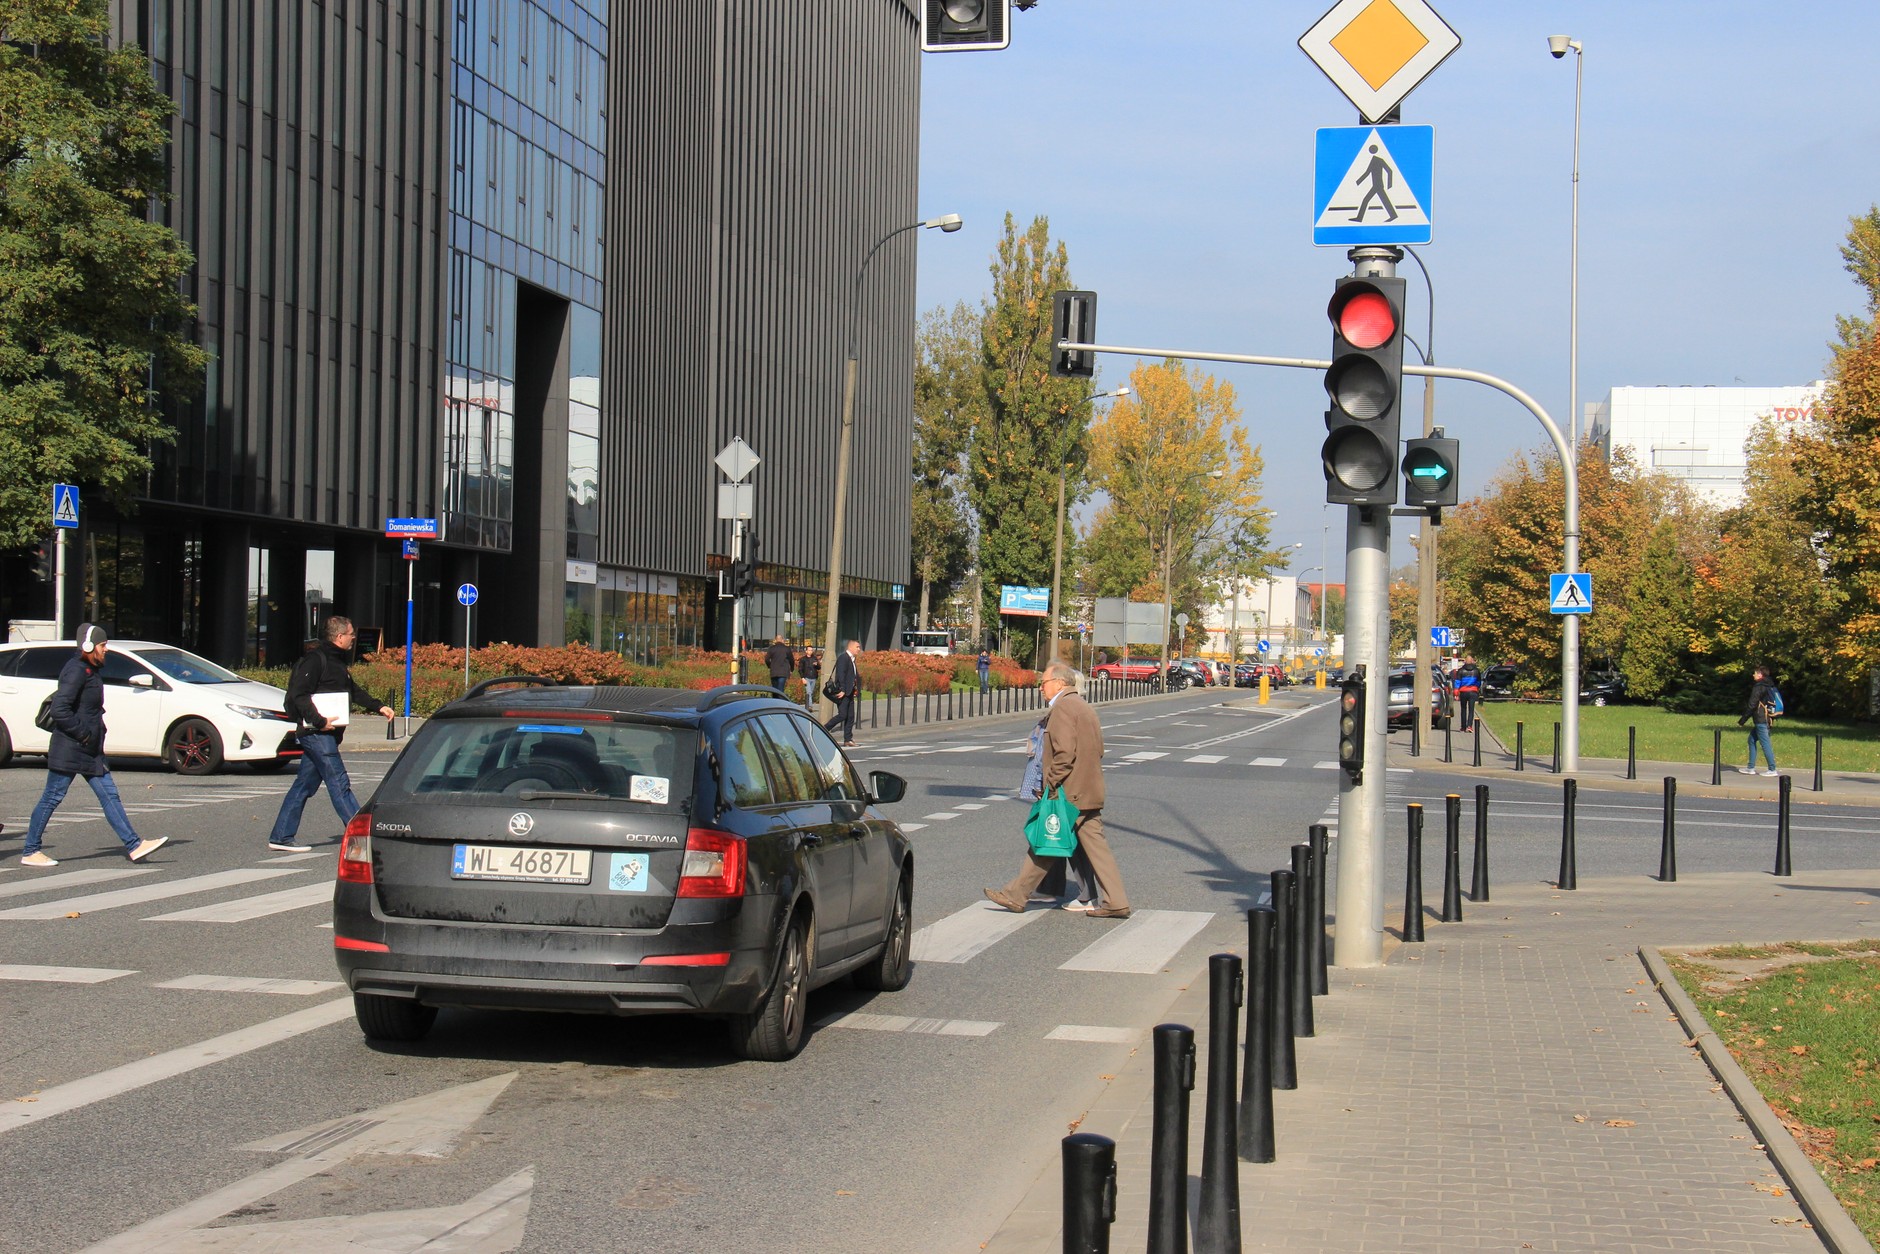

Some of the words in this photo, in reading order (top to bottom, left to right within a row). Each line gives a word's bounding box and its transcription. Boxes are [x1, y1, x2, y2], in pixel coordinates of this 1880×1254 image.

[388, 522, 434, 531] Domaniewska
[1006, 593, 1016, 605] P
[376, 822, 412, 832] ŠKODA
[626, 833, 679, 844] OCTAVIA
[455, 861, 464, 869] PL
[471, 848, 499, 872] WL
[510, 850, 582, 876] 4687L
[614, 871, 632, 887] BABY
